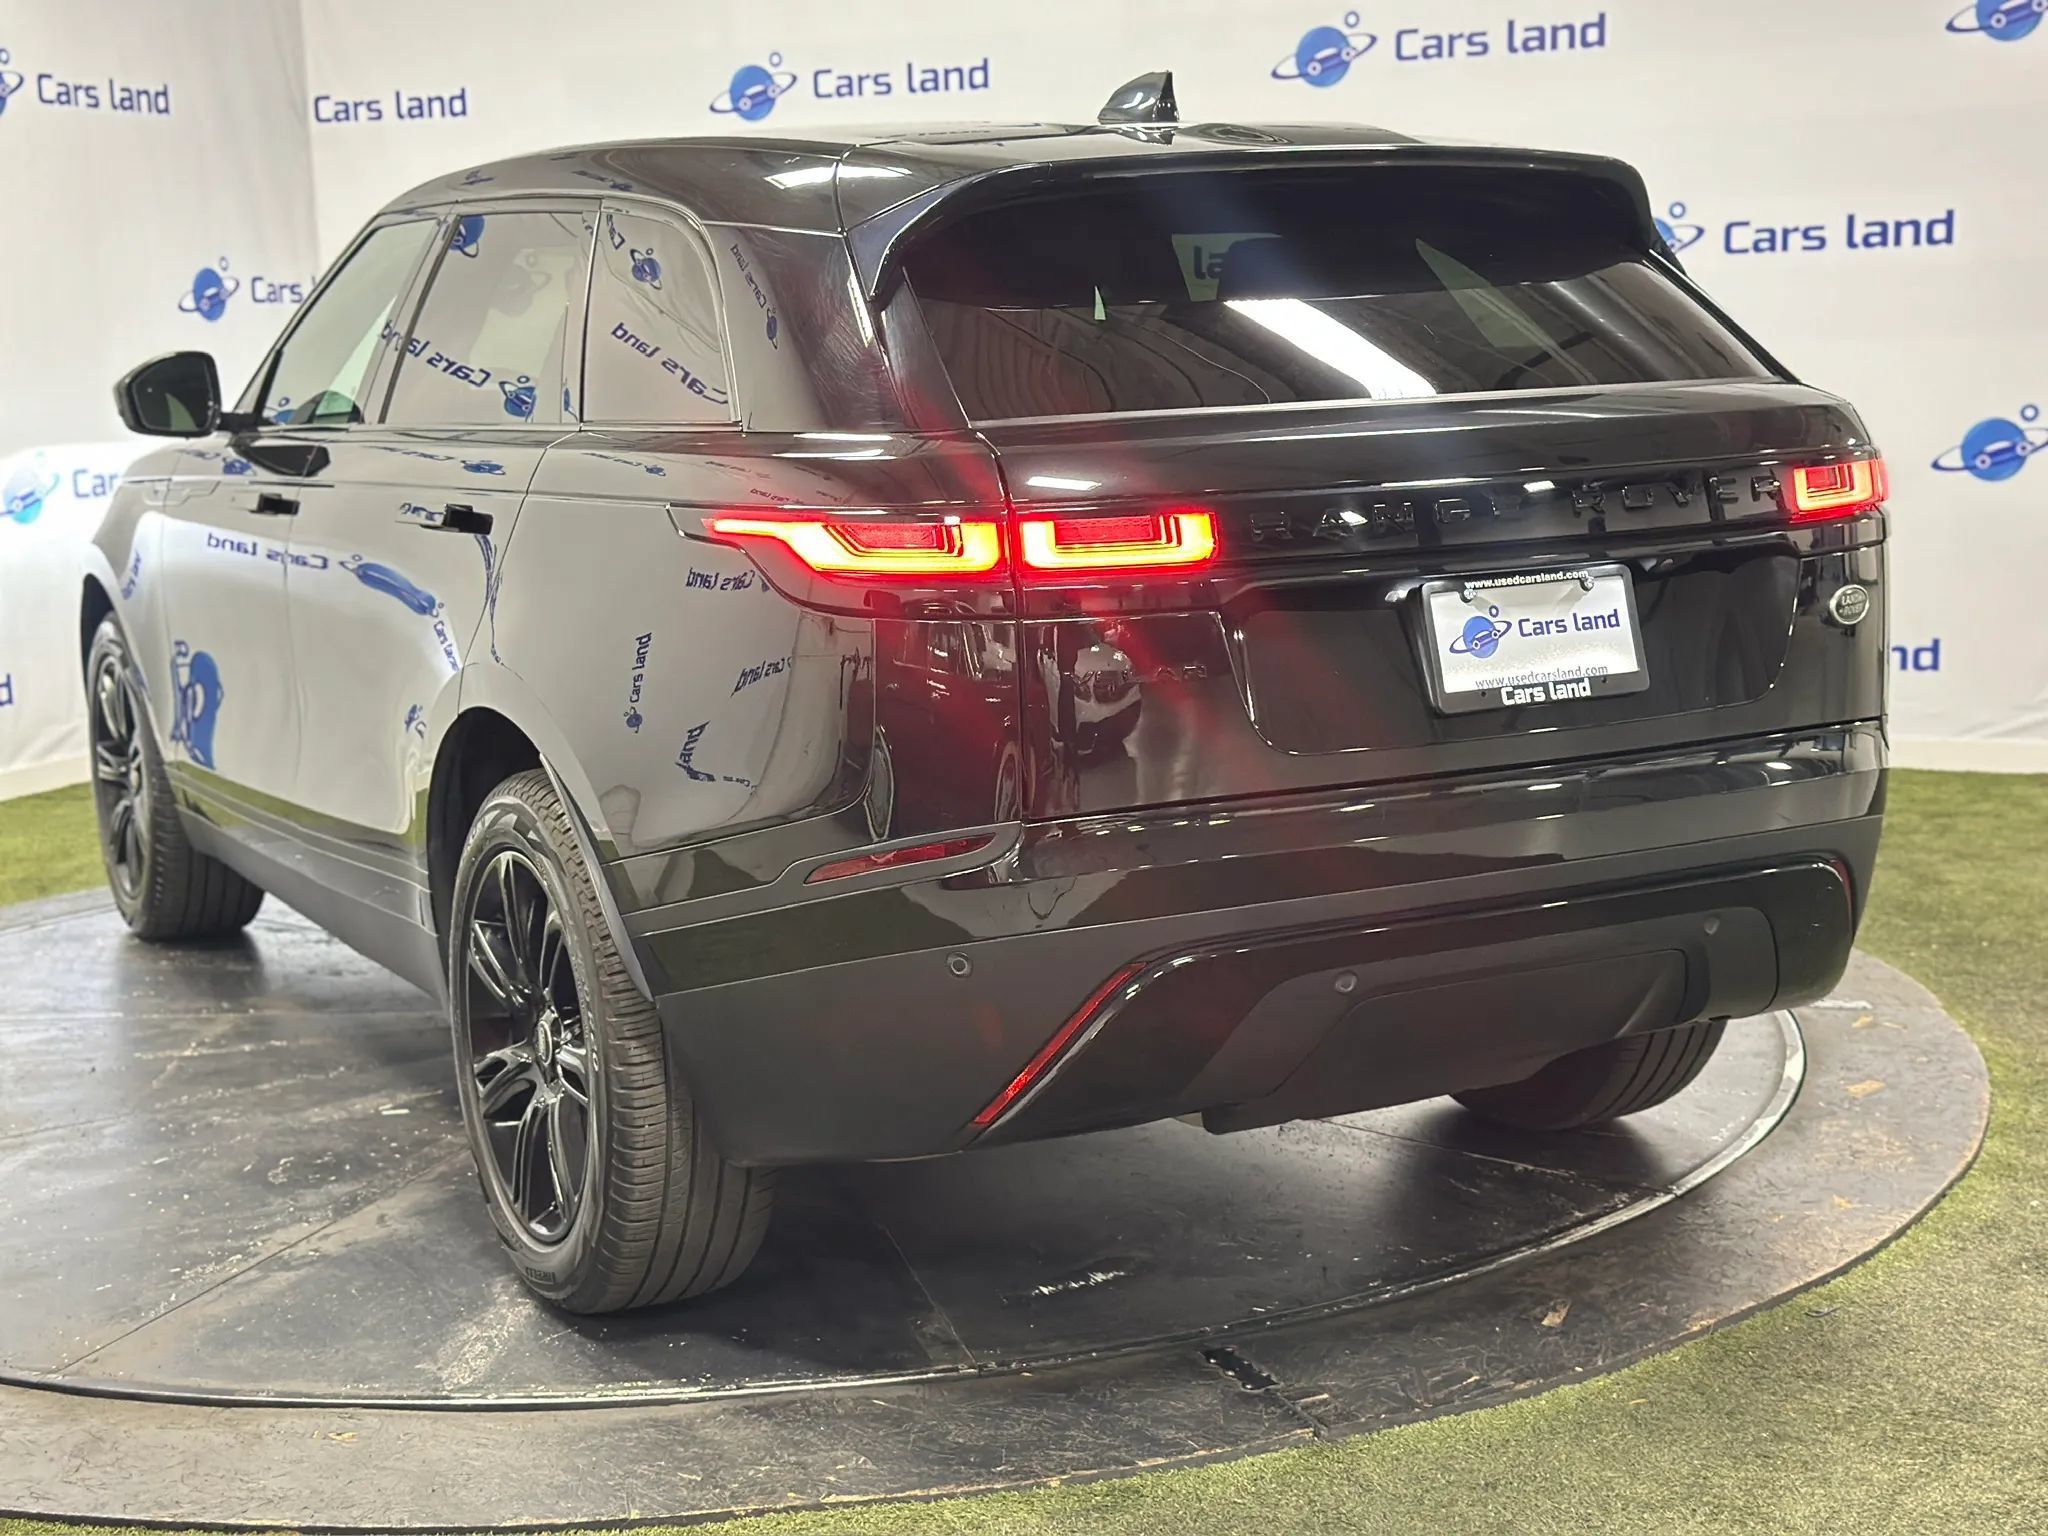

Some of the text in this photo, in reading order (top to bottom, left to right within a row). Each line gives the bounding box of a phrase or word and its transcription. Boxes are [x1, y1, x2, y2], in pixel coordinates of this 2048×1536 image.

[1395, 12, 1606, 61] Cars land
[37, 73, 170, 115] Cars land
[813, 57, 988, 98] Cars land
[314, 87, 467, 123] Cars land
[1724, 209, 1954, 254] Cars land
[1193, 245, 1222, 280] la
[251, 276, 304, 303] Cars
[73, 468, 118, 498] Car
[1571, 474, 1783, 517] ROVER
[1464, 570, 1588, 589] www.usedcarsland.com
[1518, 609, 1620, 637] Cars land
[629, 632, 652, 703] Cars land
[1891, 638, 1941, 671] nd
[1475, 665, 1608, 689] www.usedcarsland.com
[1500, 677, 1591, 706] Cars land
